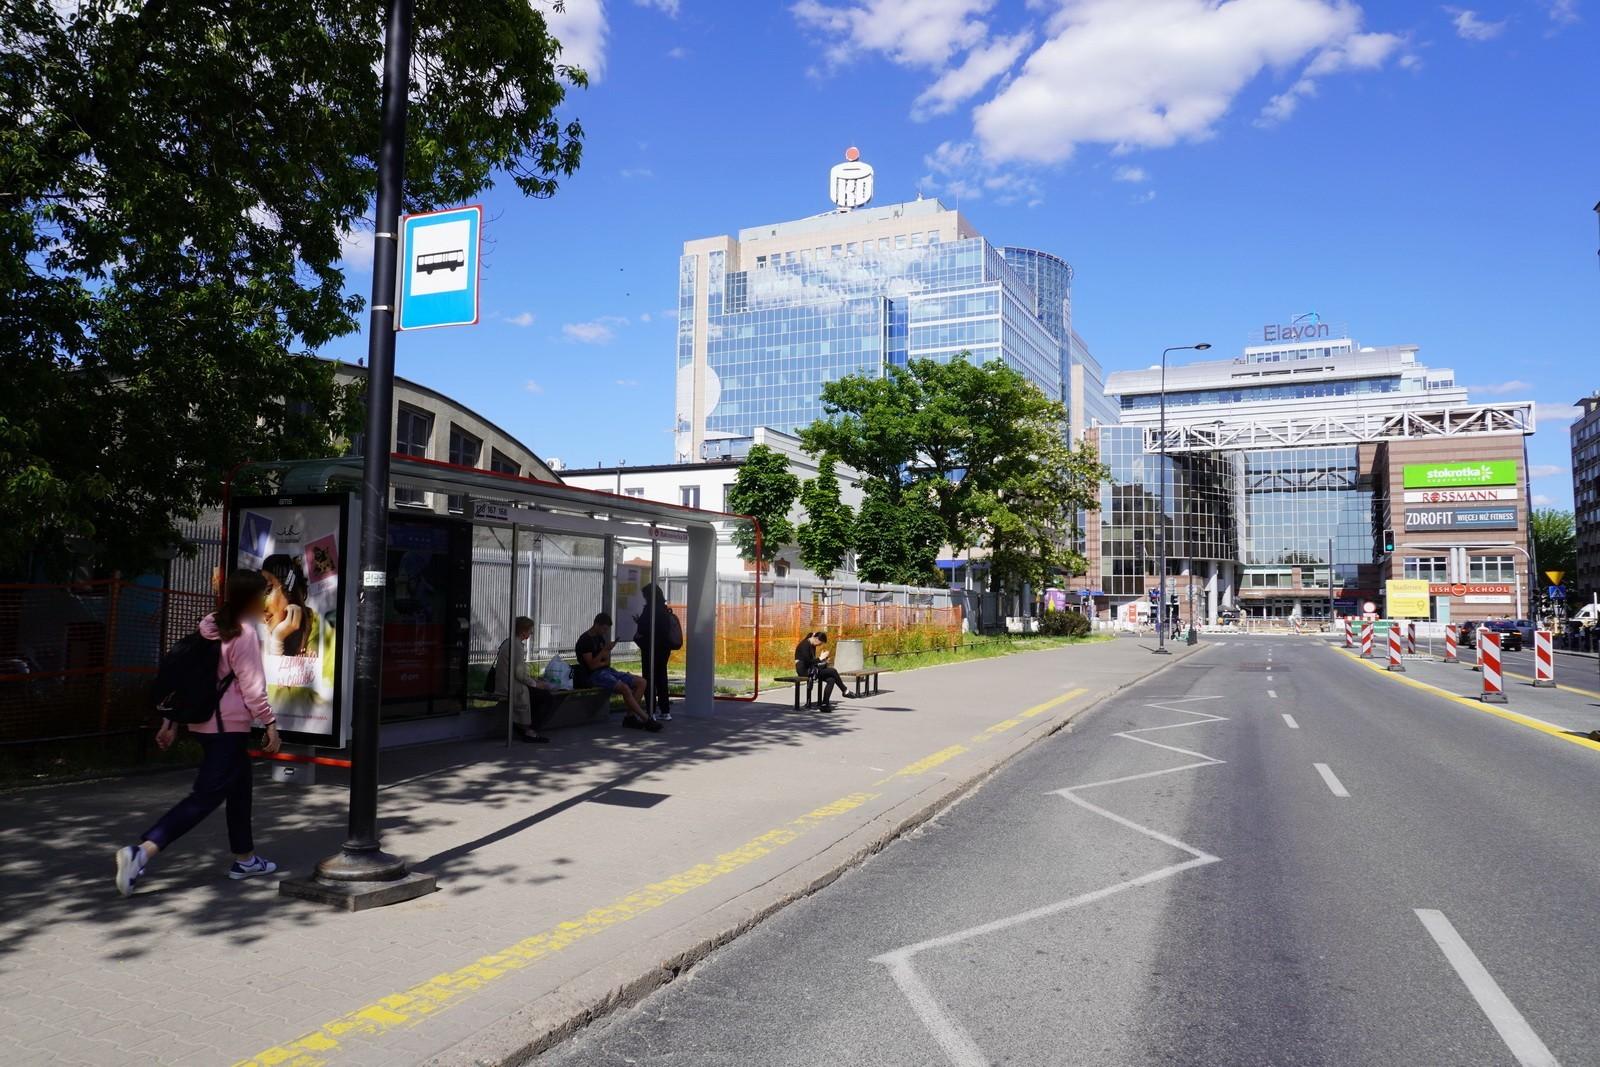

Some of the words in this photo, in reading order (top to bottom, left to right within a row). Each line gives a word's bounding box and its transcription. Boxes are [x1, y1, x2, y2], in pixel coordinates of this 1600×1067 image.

[1426, 466, 1481, 479] stokrotka
[1422, 489, 1498, 503] ROSSMANN
[1406, 511, 1453, 526] ZDROFIT
[1457, 513, 1478, 522] WIĘCEJ
[1490, 512, 1514, 521] FITNESS
